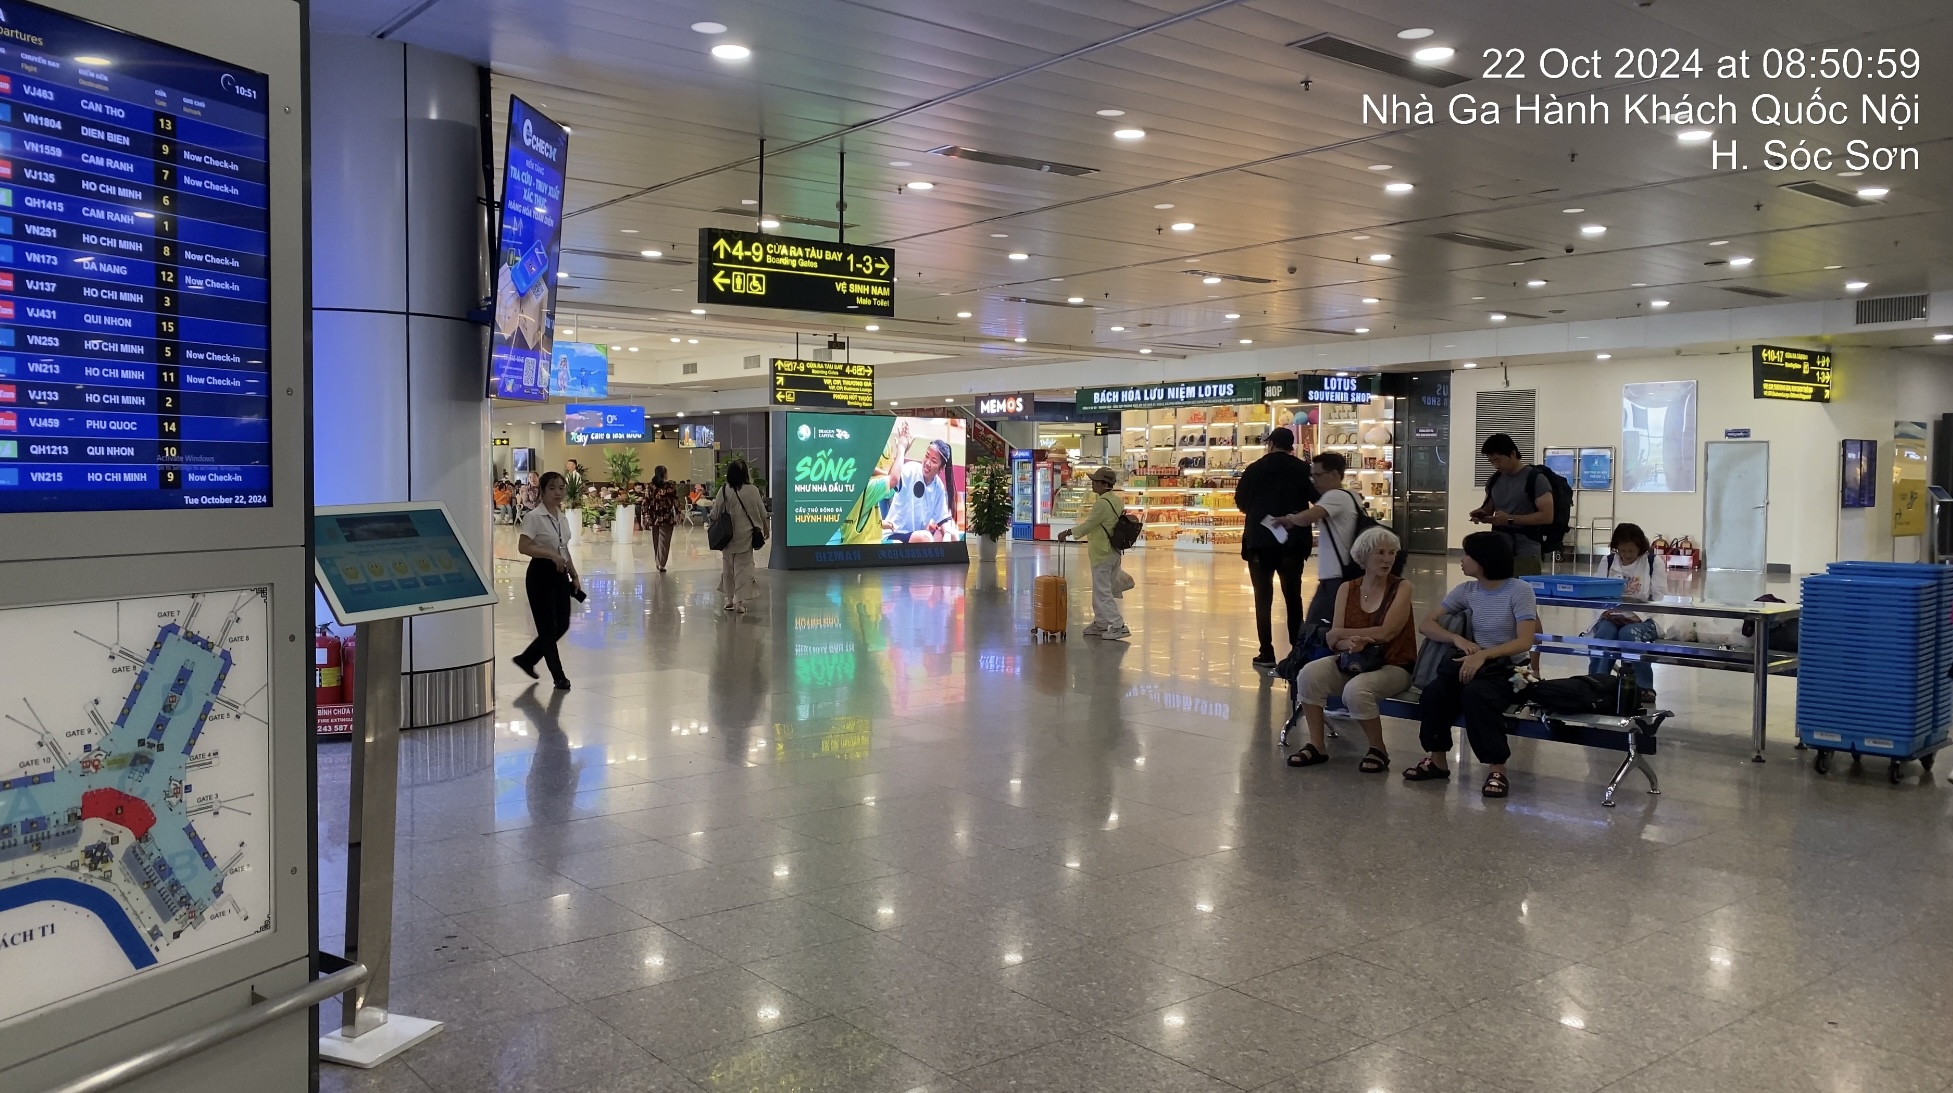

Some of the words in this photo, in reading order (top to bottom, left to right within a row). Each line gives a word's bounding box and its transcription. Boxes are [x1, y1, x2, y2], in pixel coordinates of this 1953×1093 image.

[235, 85, 257, 99] 10:51
[23, 84, 54, 101] VJ463
[81, 100, 103, 113] CAN
[105, 104, 125, 118] THO
[159, 118, 172, 131] 13
[23, 112, 62, 130] VN1804
[81, 126, 104, 141] DIEN
[107, 131, 130, 146] BIEN
[162, 144, 169, 155] 9
[184, 150, 202, 163] Now
[204, 155, 239, 171] Check-in
[24, 140, 62, 157] VN1559
[81, 153, 104, 167] CAM
[106, 158, 134, 173] RANH
[162, 170, 169, 180] 7
[184, 175, 202, 187] Now
[204, 180, 239, 196] Check-in
[24, 168, 55, 183] VJ135
[82, 180, 98, 192] HO
[99, 183, 116, 195] CHI
[118, 186, 142, 200] MINH
[162, 195, 170, 206] 6
[24, 196, 64, 213] QH1415
[82, 207, 105, 220] CAM
[107, 211, 134, 225] RANH
[163, 221, 169, 231] 1
[732, 240, 763, 262] 4-9
[767, 243, 788, 256] CỬA
[790, 246, 803, 257] RA
[805, 246, 823, 259] TÀU
[825, 250, 843, 262] BAY
[767, 255, 797, 268] Boarding
[798, 258, 818, 268] Gates
[847, 253, 873, 274] 1-3
[25, 252, 58, 266] VN173
[83, 261, 97, 272] DA
[99, 263, 127, 276] NANG
[161, 271, 173, 282] 12
[185, 275, 203, 286] Now
[205, 278, 240, 292] Check-in
[26, 279, 57, 293] VJ137
[83, 287, 99, 298] HO
[100, 289, 117, 301] CHI
[119, 291, 143, 304] MINH
[164, 296, 171, 307] 3
[835, 281, 847, 294] VỆ
[849, 283, 869, 294] SINH
[871, 285, 890, 296] NAM
[857, 296, 871, 305] Male
[873, 298, 889, 307] Toilet
[26, 307, 57, 320] VJ431
[84, 313, 101, 325] QUI
[103, 315, 131, 328] NHON
[162, 321, 174, 332] 15
[1767, 349, 1784, 363] 10-17
[793, 362, 805, 372] 7-9
[845, 365, 856, 375] 4-6
[1324, 377, 1357, 391] LOTUS
[1094, 390, 1121, 404] BÁCH
[1122, 387, 1141, 402] HÓA
[1144, 387, 1164, 401] LƯU
[1168, 384, 1195, 401] NIỆM
[1198, 384, 1234, 398] LOTUS
[1308, 390, 1348, 402] SOUVENIR
[1350, 392, 1371, 403] SHOP
[980, 397, 1023, 413] MEMOS
[29, 417, 60, 428] VJ459
[86, 420, 106, 431] PHU
[109, 420, 137, 431] QUOC
[163, 421, 176, 433] 14
[29, 444, 68, 455] QH1213
[87, 446, 104, 456] QUI
[106, 446, 134, 456] NHON
[164, 447, 176, 457] 10
[157, 455, 183, 463] Activate
[795, 448, 857, 483] SỐNG
[30, 472, 63, 482] VN215
[88, 472, 102, 482] HO
[104, 472, 121, 482] CHI
[123, 472, 147, 482] MINH
[167, 471, 174, 481] 9
[188, 473, 206, 481] Now
[208, 473, 242, 481] Check-in
[795, 484, 811, 492] NHƯ
[812, 482, 827, 492] NHÀ
[845, 484, 855, 492] TƯ
[184, 496, 199, 504] Tue
[201, 495, 233, 504] October
[235, 495, 247, 505] 22,
[248, 495, 267, 503] 2024
[795, 513, 822, 523] HUỲNH
[823, 514, 841, 523] NHƯ
[815, 551, 862, 562] BIZMAN
[112, 666, 131, 674] GATE
[209, 714, 224, 722] GATE
[65, 729, 85, 738] GATE
[19, 759, 39, 768] GATE
[189, 754, 206, 762] GATE
[38, 922, 55, 937] T1
